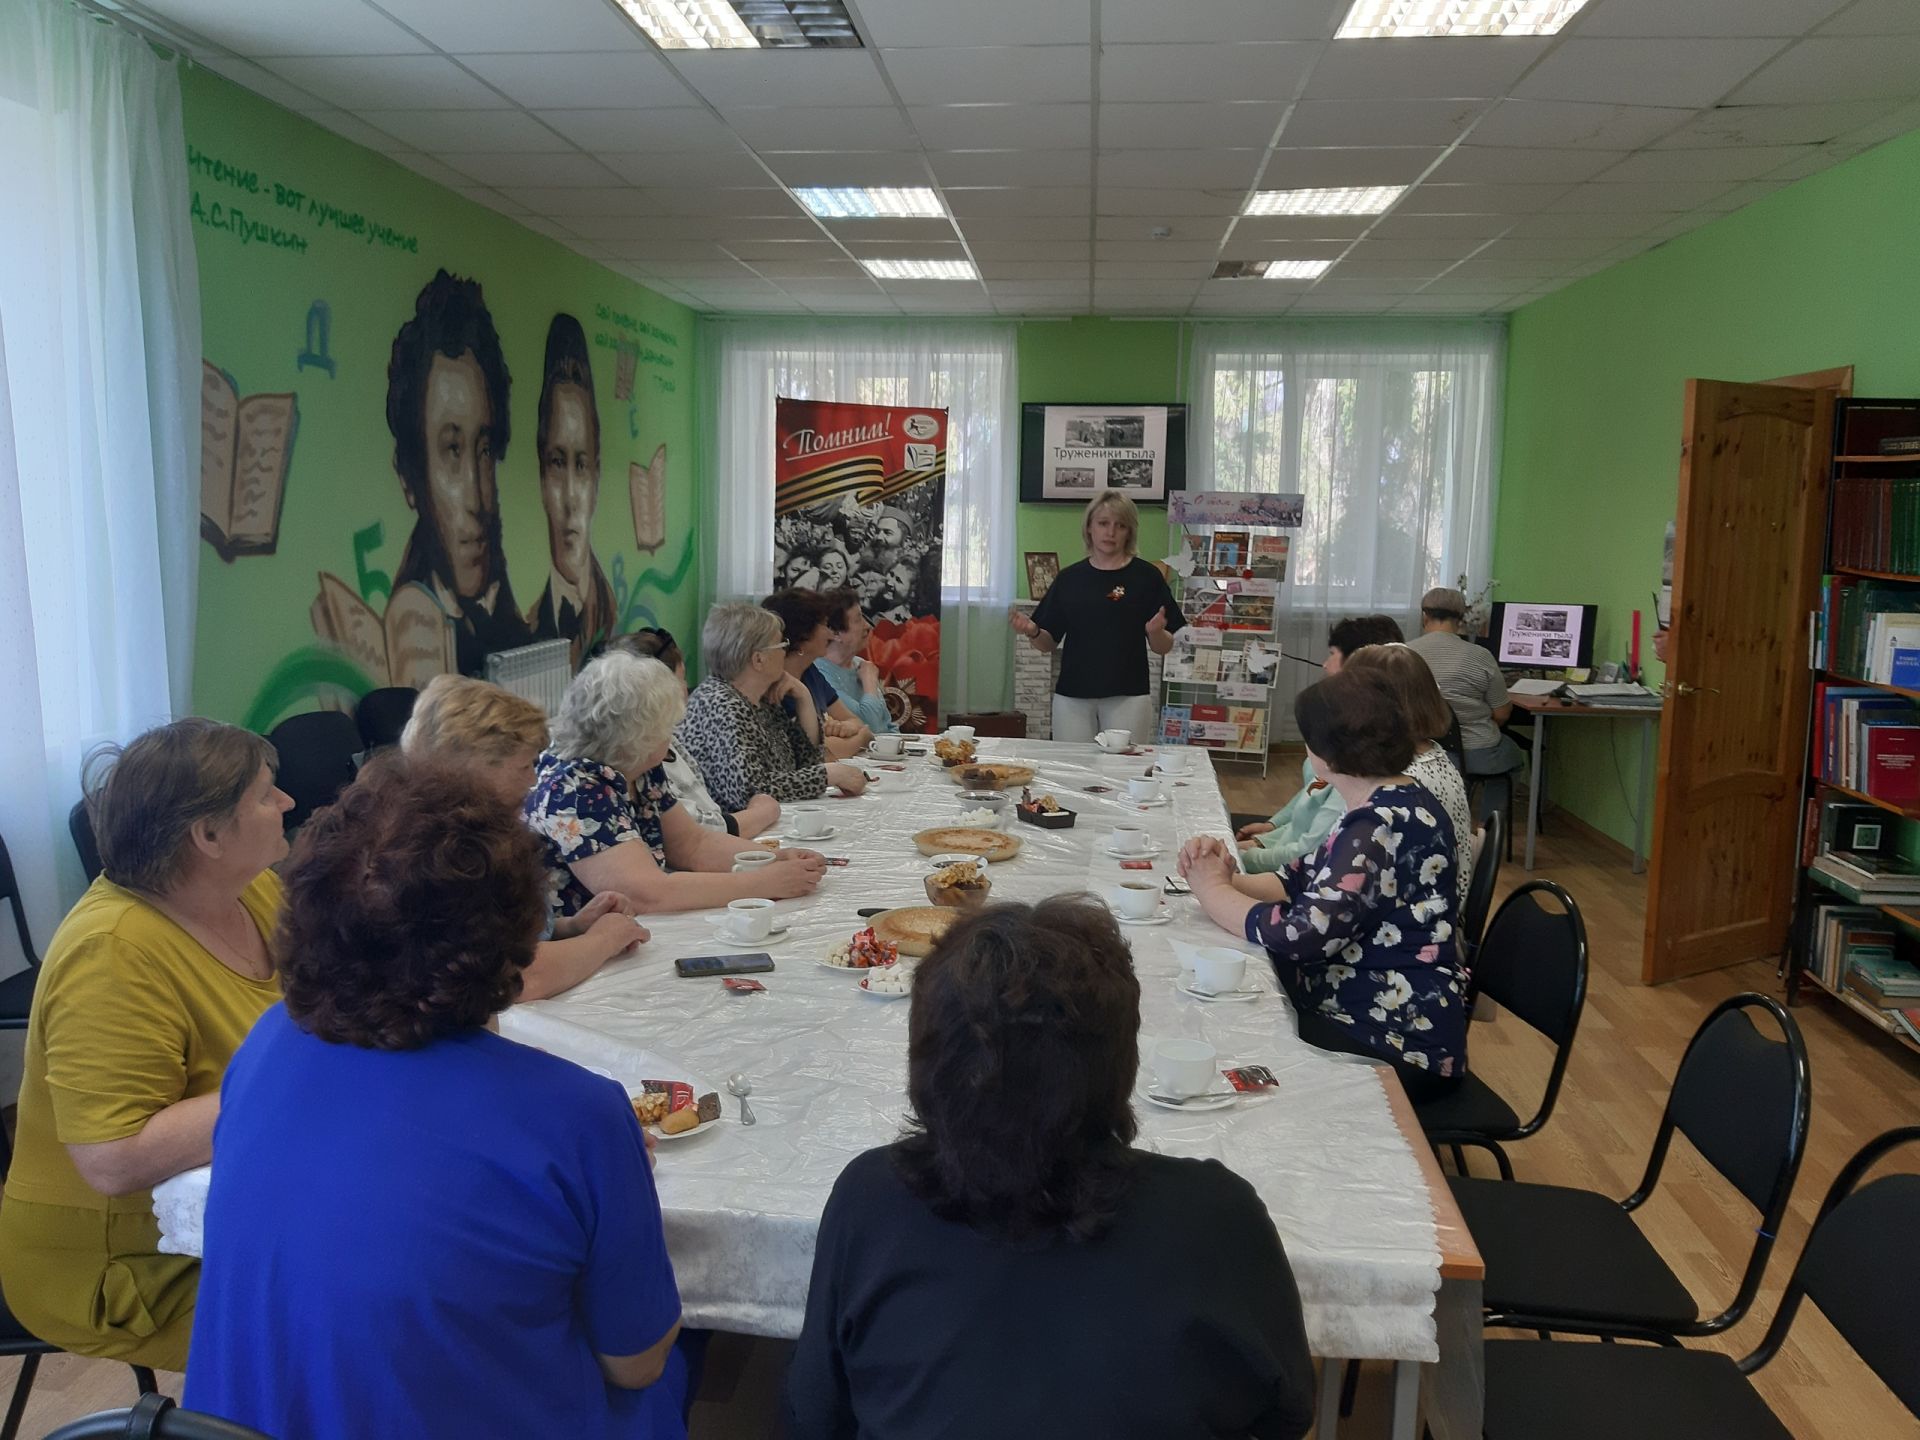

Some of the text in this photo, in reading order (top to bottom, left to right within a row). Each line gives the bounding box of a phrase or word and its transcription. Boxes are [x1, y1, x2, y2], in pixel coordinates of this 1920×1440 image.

[783, 412, 892, 456] Помним!
[1053, 447, 1156, 461] Труженики тыла
[1508, 629, 1574, 640] Труженики тыла
